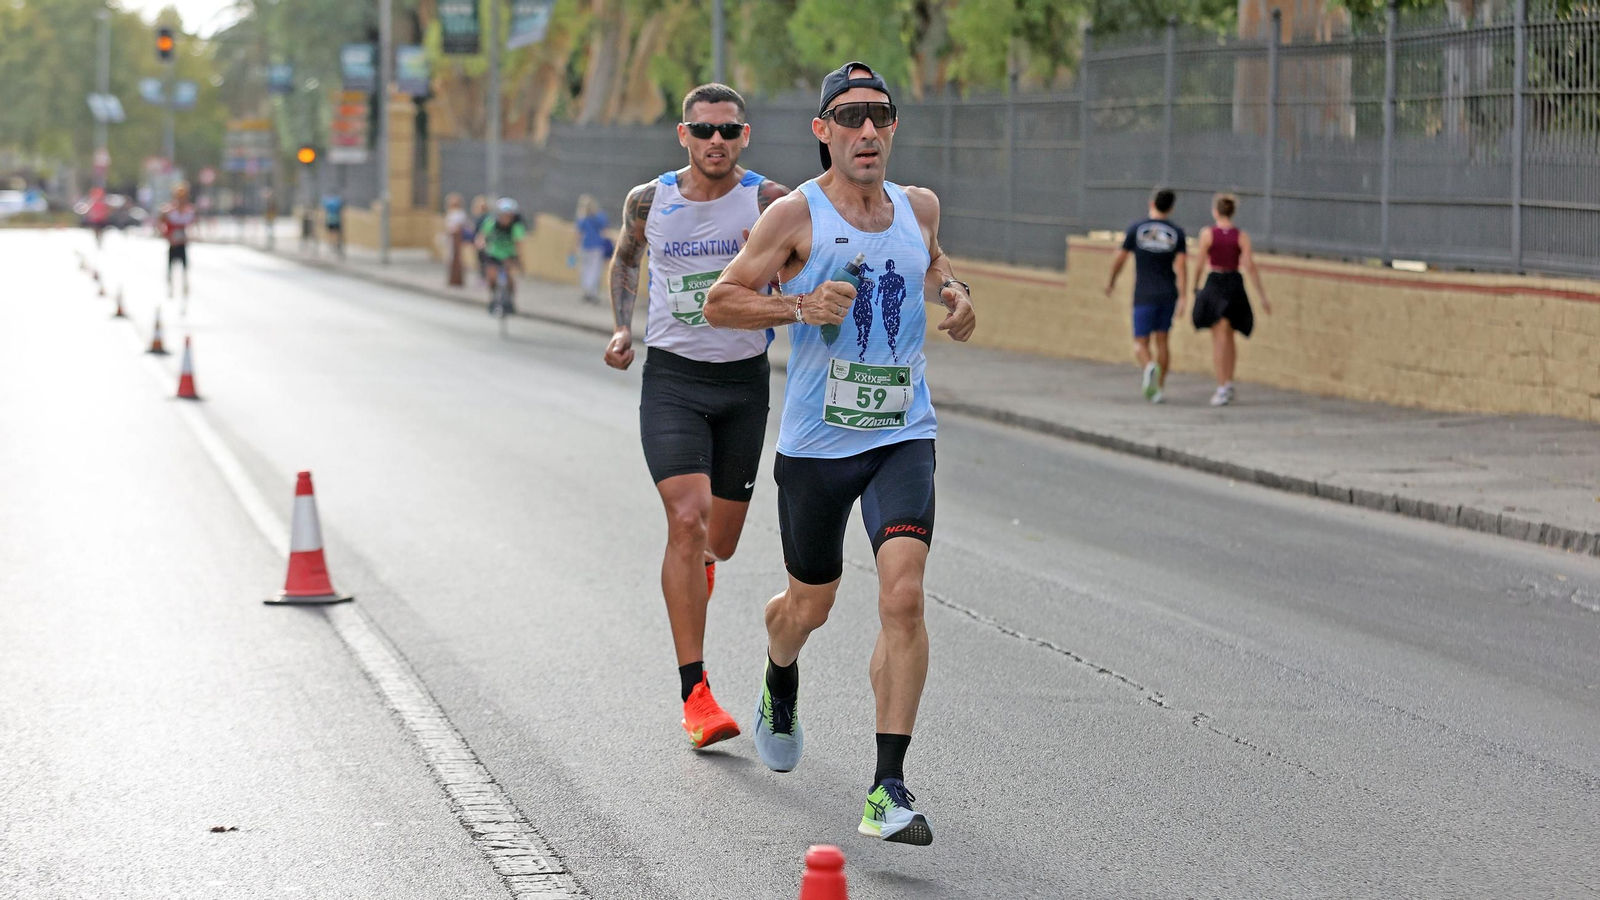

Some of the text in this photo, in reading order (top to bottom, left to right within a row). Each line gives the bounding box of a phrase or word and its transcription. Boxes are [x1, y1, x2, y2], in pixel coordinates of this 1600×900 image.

[664, 239, 740, 257] ARGENTINA
[853, 373, 878, 384] XXIX
[856, 386, 887, 410] 59
